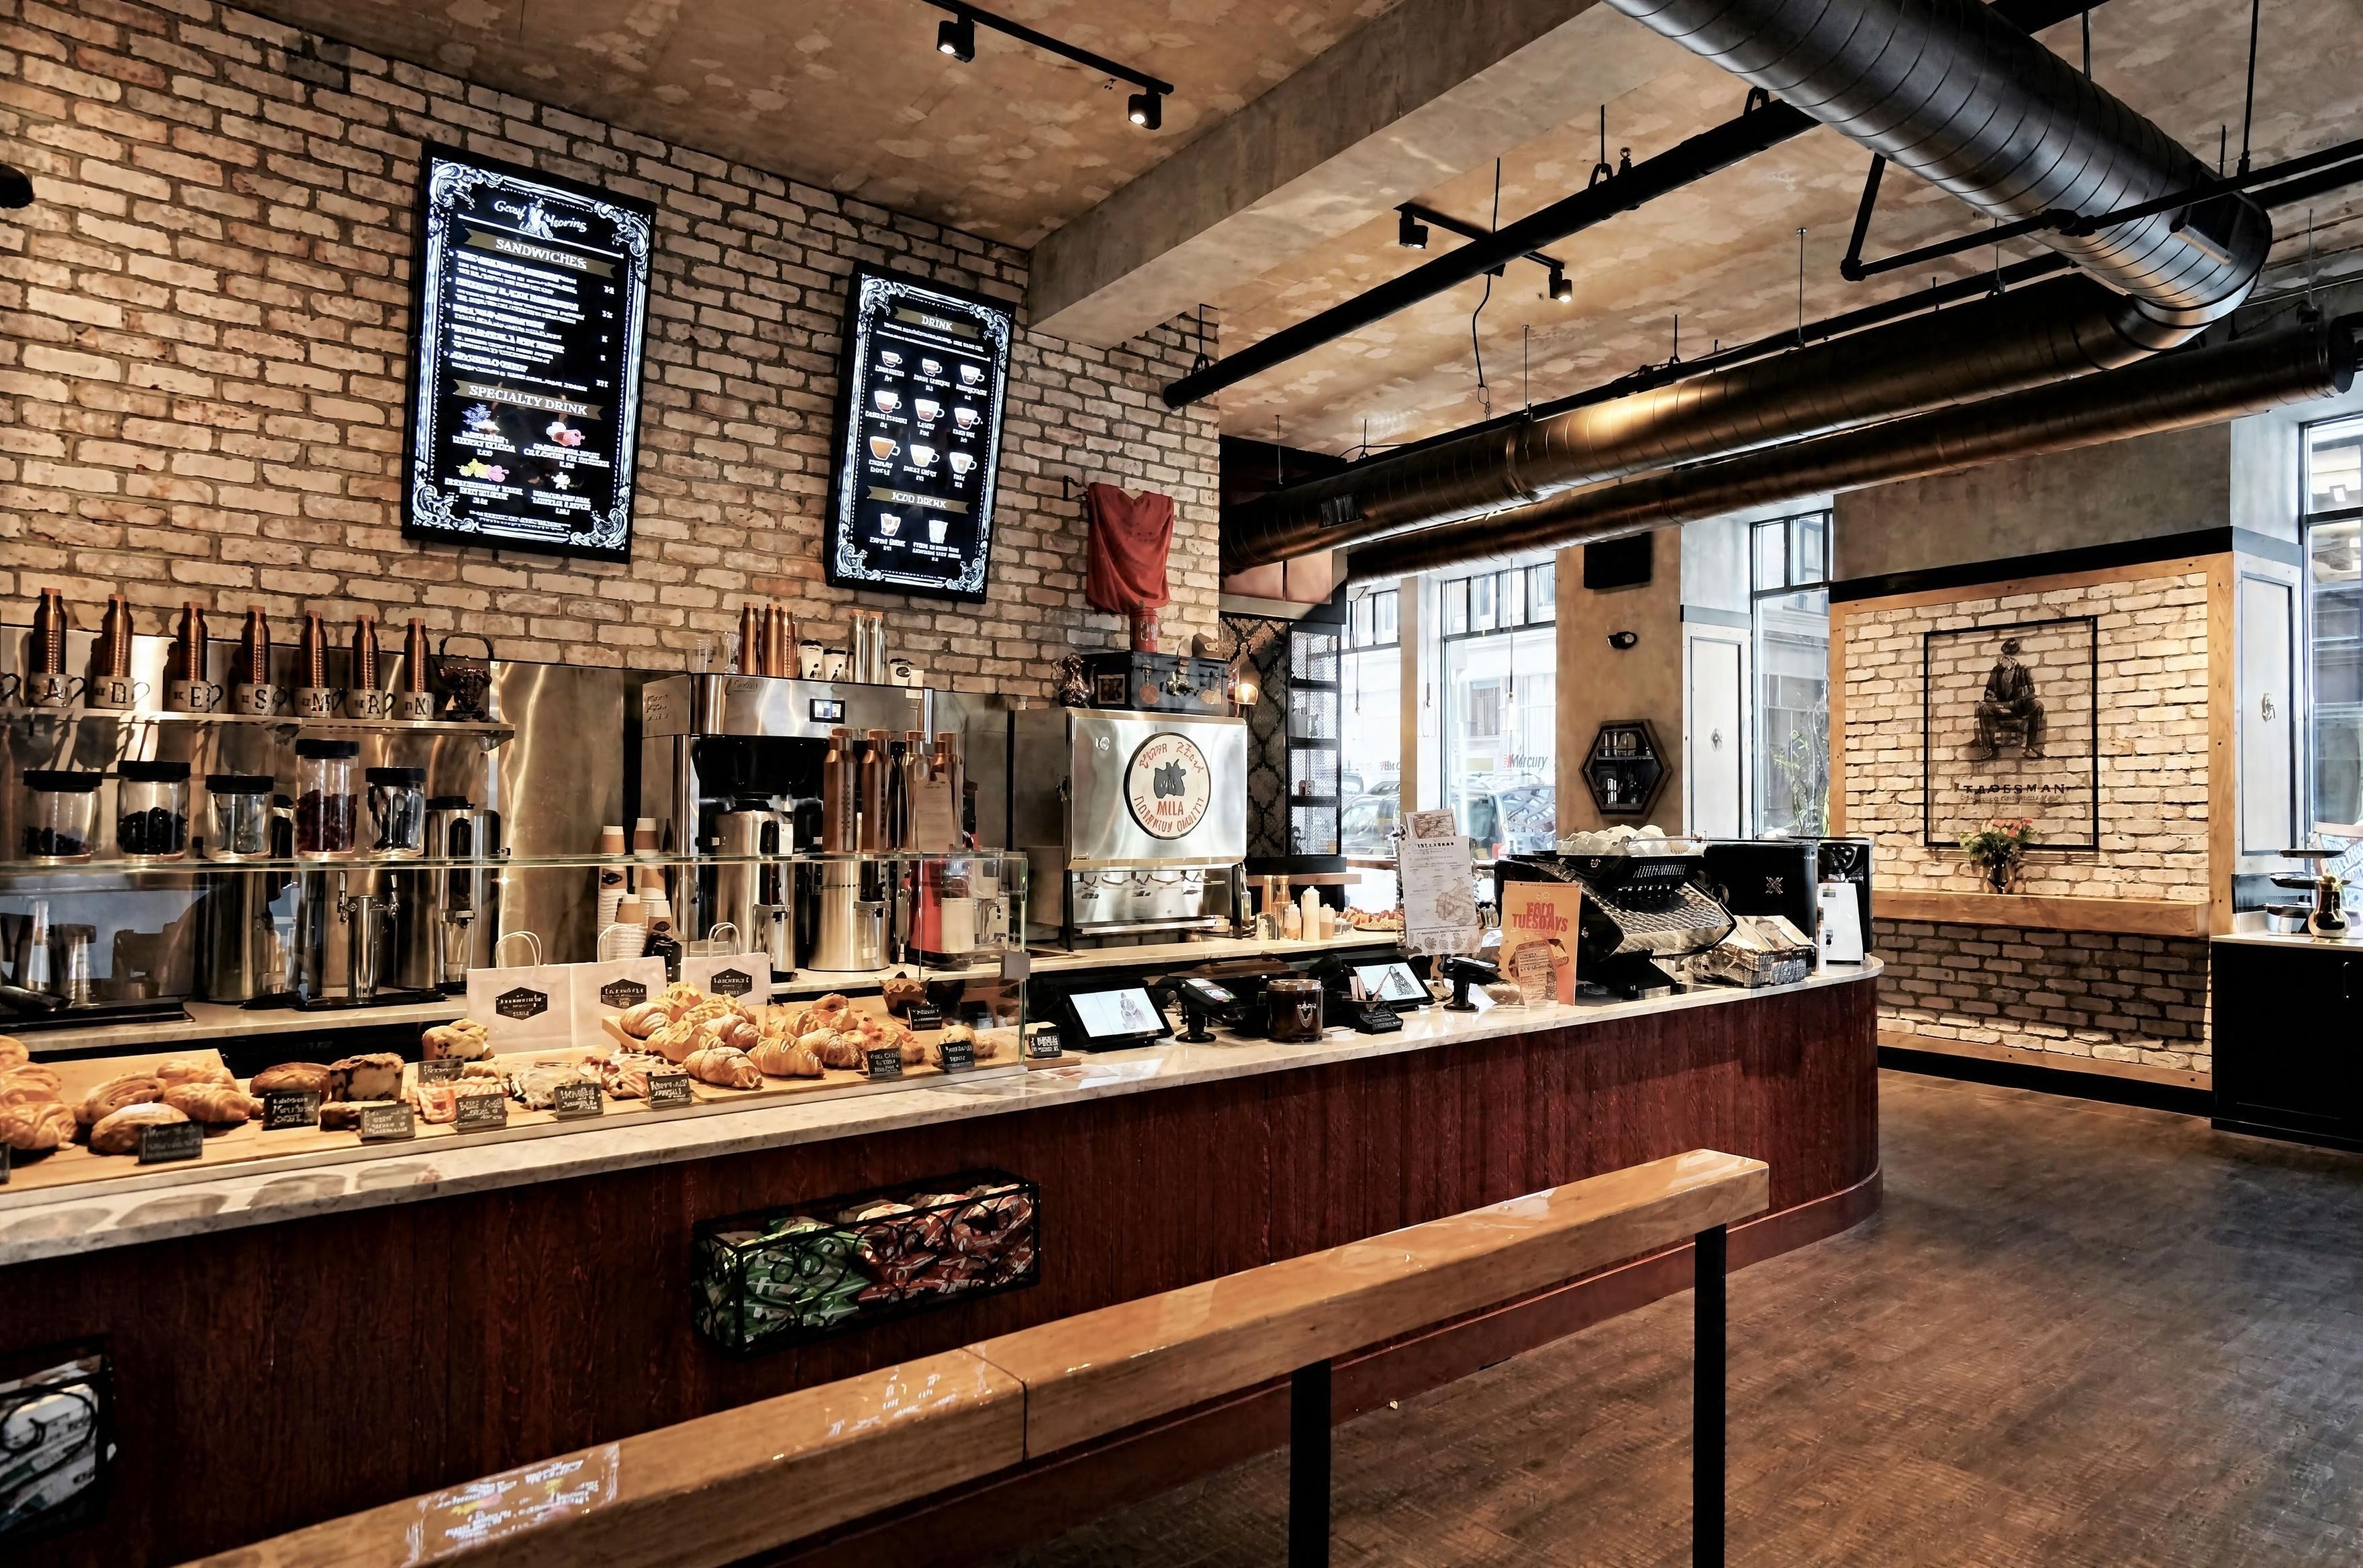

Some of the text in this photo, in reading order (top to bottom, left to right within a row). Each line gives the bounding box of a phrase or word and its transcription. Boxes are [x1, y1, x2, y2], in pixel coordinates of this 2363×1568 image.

[495, 238, 587, 270] SANDWICHES
[921, 315, 953, 332] DRINK
[469, 385, 588, 415] SPECIALTY DRINK
